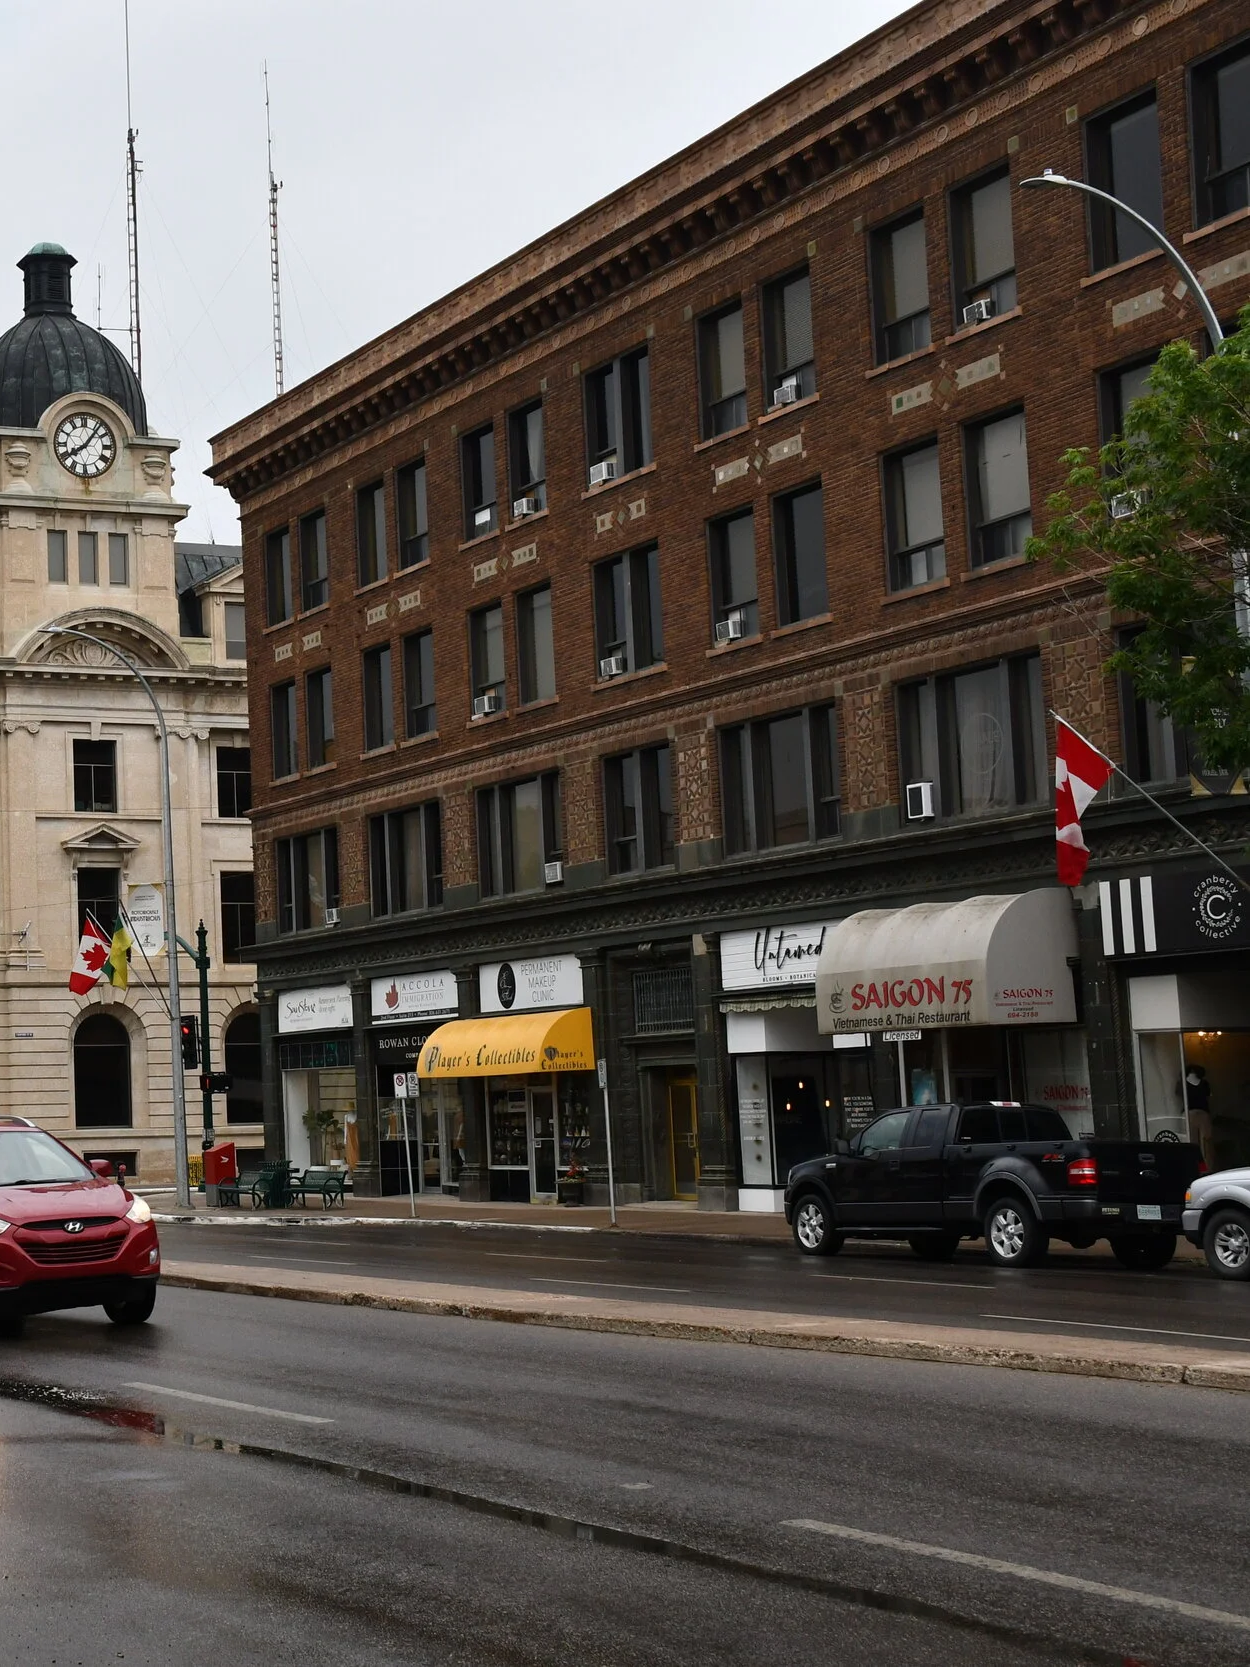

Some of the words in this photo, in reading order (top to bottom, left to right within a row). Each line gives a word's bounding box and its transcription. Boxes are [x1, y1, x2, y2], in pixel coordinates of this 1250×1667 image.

[1193, 875, 1238, 898] cranberry
[1195, 916, 1241, 939] collective
[754, 926, 827, 977] Untamed
[520, 960, 562, 976] PERMANENT
[401, 978, 444, 992] ACCOLA
[528, 974, 557, 989] MAKEUP
[401, 991, 444, 1004] IMMIGRATION
[531, 988, 555, 1003] CLINIC
[851, 975, 946, 1011] SAIGON
[951, 978, 974, 1005] 75
[1003, 988, 1043, 999] SAIGON
[1044, 989, 1054, 998] 75
[833, 1015, 884, 1030] Vietnamese
[885, 1014, 893, 1026] &
[895, 1012, 916, 1025] Thai
[918, 1010, 971, 1024] Restaurant
[379, 1037, 409, 1049] ROWAN
[884, 1030, 920, 1041] Licensed
[428, 1046, 471, 1072] Player's
[475, 1044, 536, 1067] Collectibles
[549, 1048, 584, 1060] Player's
[541, 1058, 588, 1070] Collectibles
[1043, 1084, 1079, 1101] SAIGON
